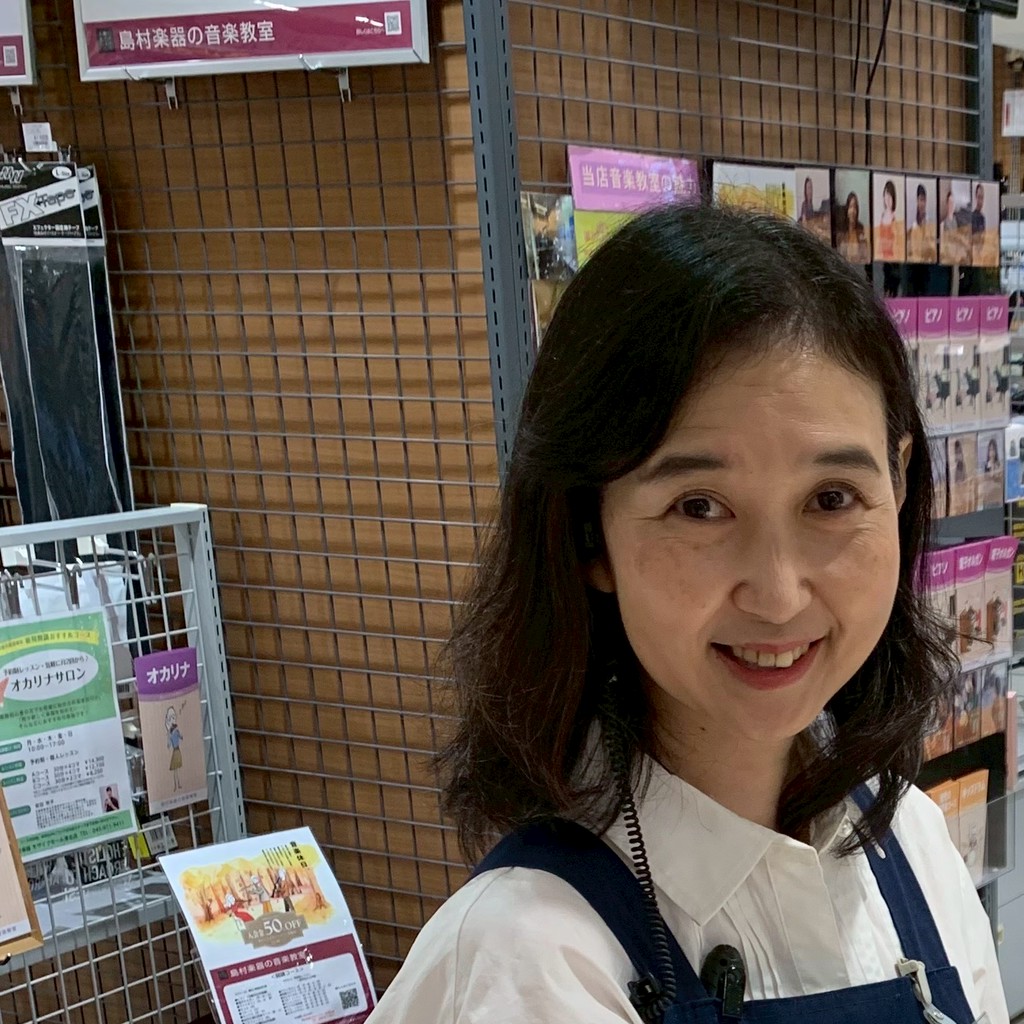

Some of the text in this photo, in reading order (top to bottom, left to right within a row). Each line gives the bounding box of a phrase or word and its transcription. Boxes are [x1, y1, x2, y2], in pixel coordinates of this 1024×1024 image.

[119, 20, 276, 51] 島村楽器の音楽教室
[925, 308, 943, 323] ピアノ
[956, 307, 974, 323] ピアノ
[986, 306, 1004, 321] ピアノ
[11, 667, 86, 692] オカリナサロン
[147, 661, 191, 684] オカリナ
[264, 918, 283, 936] 50
